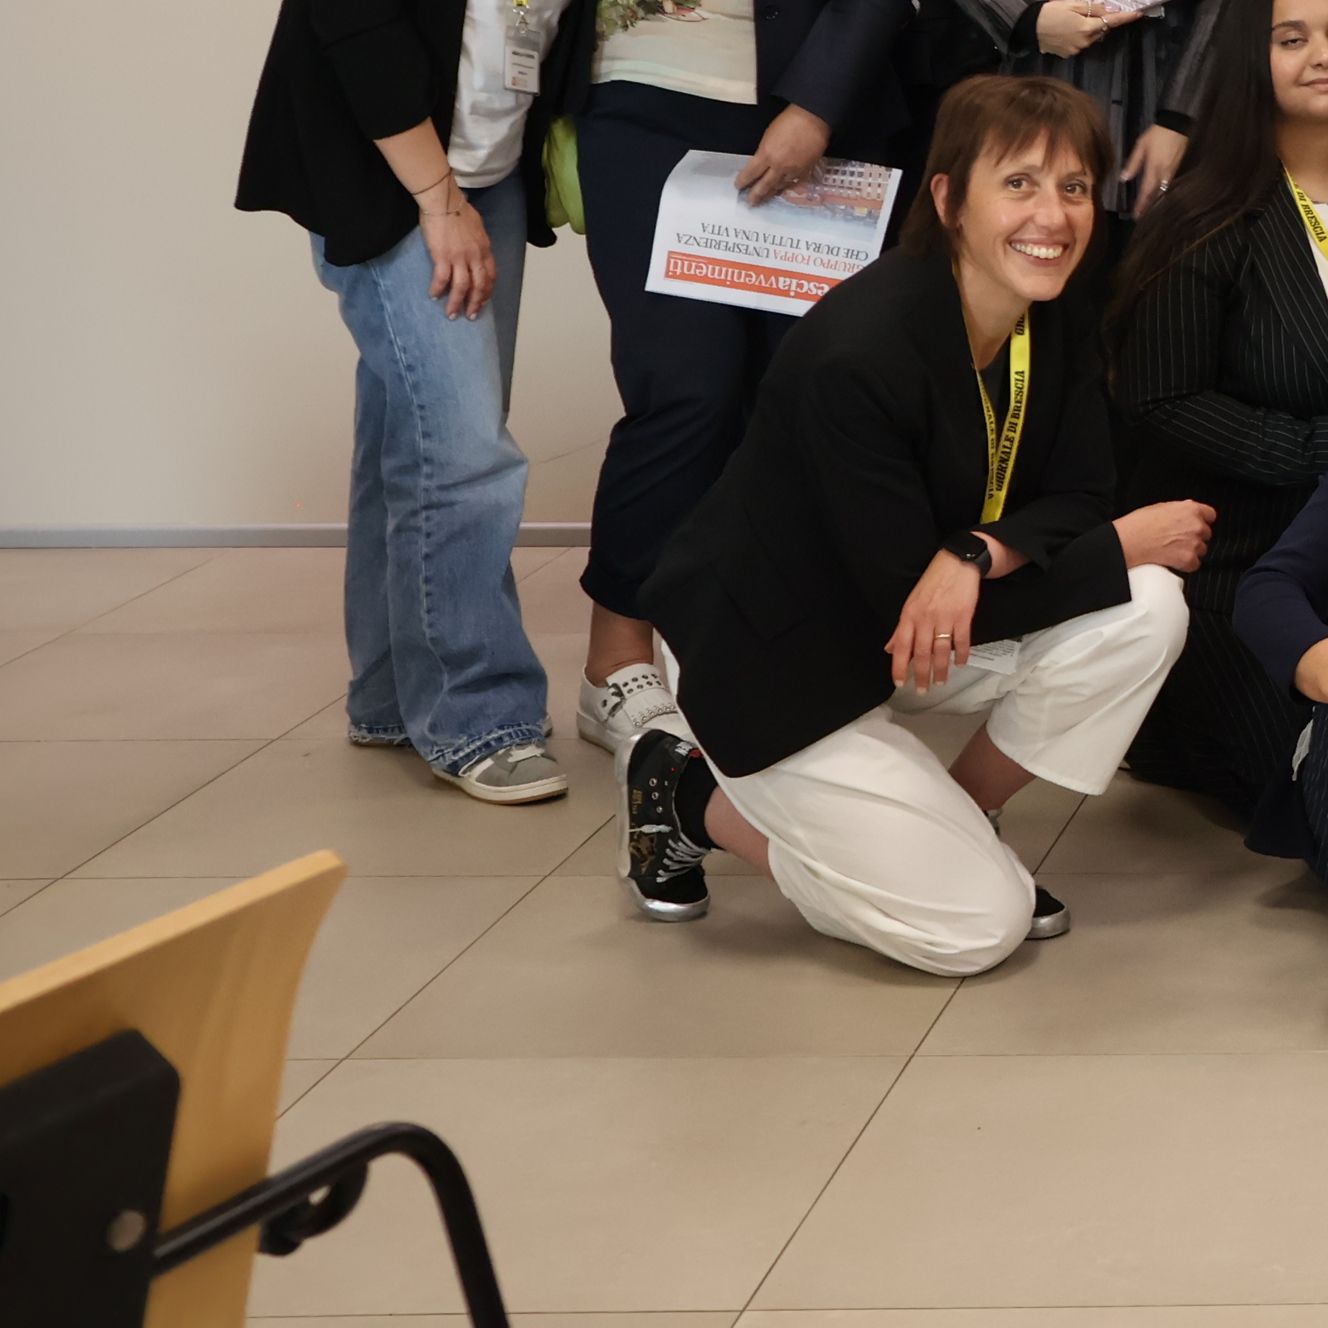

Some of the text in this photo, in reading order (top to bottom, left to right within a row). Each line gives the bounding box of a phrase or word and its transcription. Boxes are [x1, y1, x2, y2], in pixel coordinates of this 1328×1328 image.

[700, 222, 869, 261] CHE DURA TUTTA UNA VITA
[1301, 203, 1327, 242] BRESCIA
[676, 232, 811, 265] FOPPA UN'ESPERIENZA
[996, 435, 1015, 491] GIORNALE
[1011, 370, 1025, 420] BRESCIA
